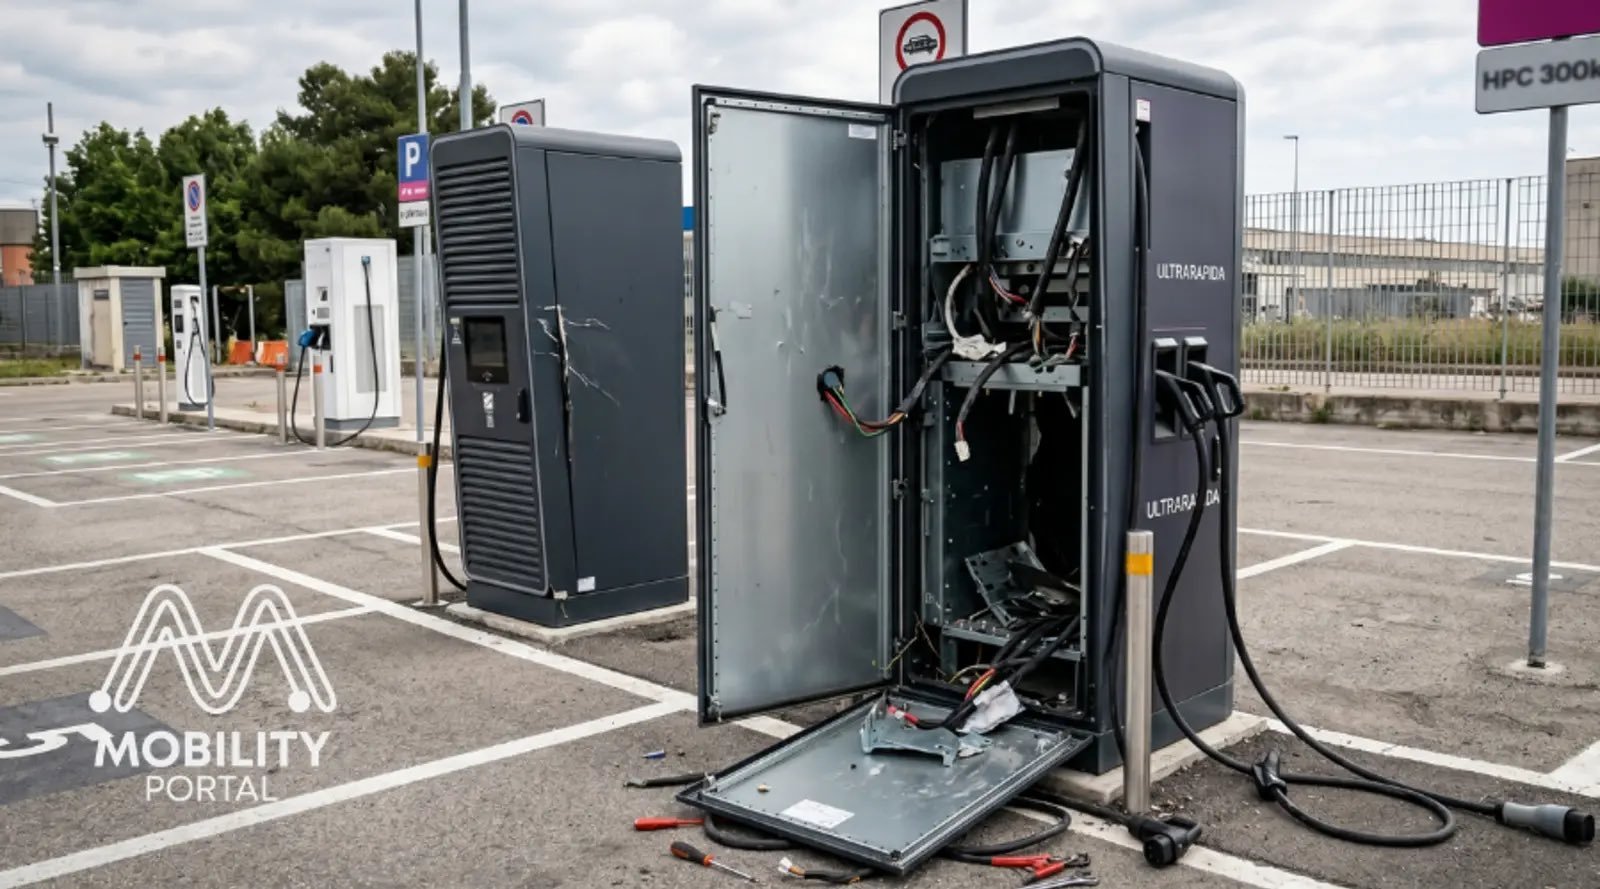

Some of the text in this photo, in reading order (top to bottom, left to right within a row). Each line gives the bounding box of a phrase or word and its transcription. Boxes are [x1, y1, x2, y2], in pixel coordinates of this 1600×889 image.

[1482, 66, 1533, 91] HPC
[405, 141, 421, 177] P
[1156, 263, 1226, 281] ULTRARAPIDA
[1146, 488, 1221, 519] ULTRARADA
